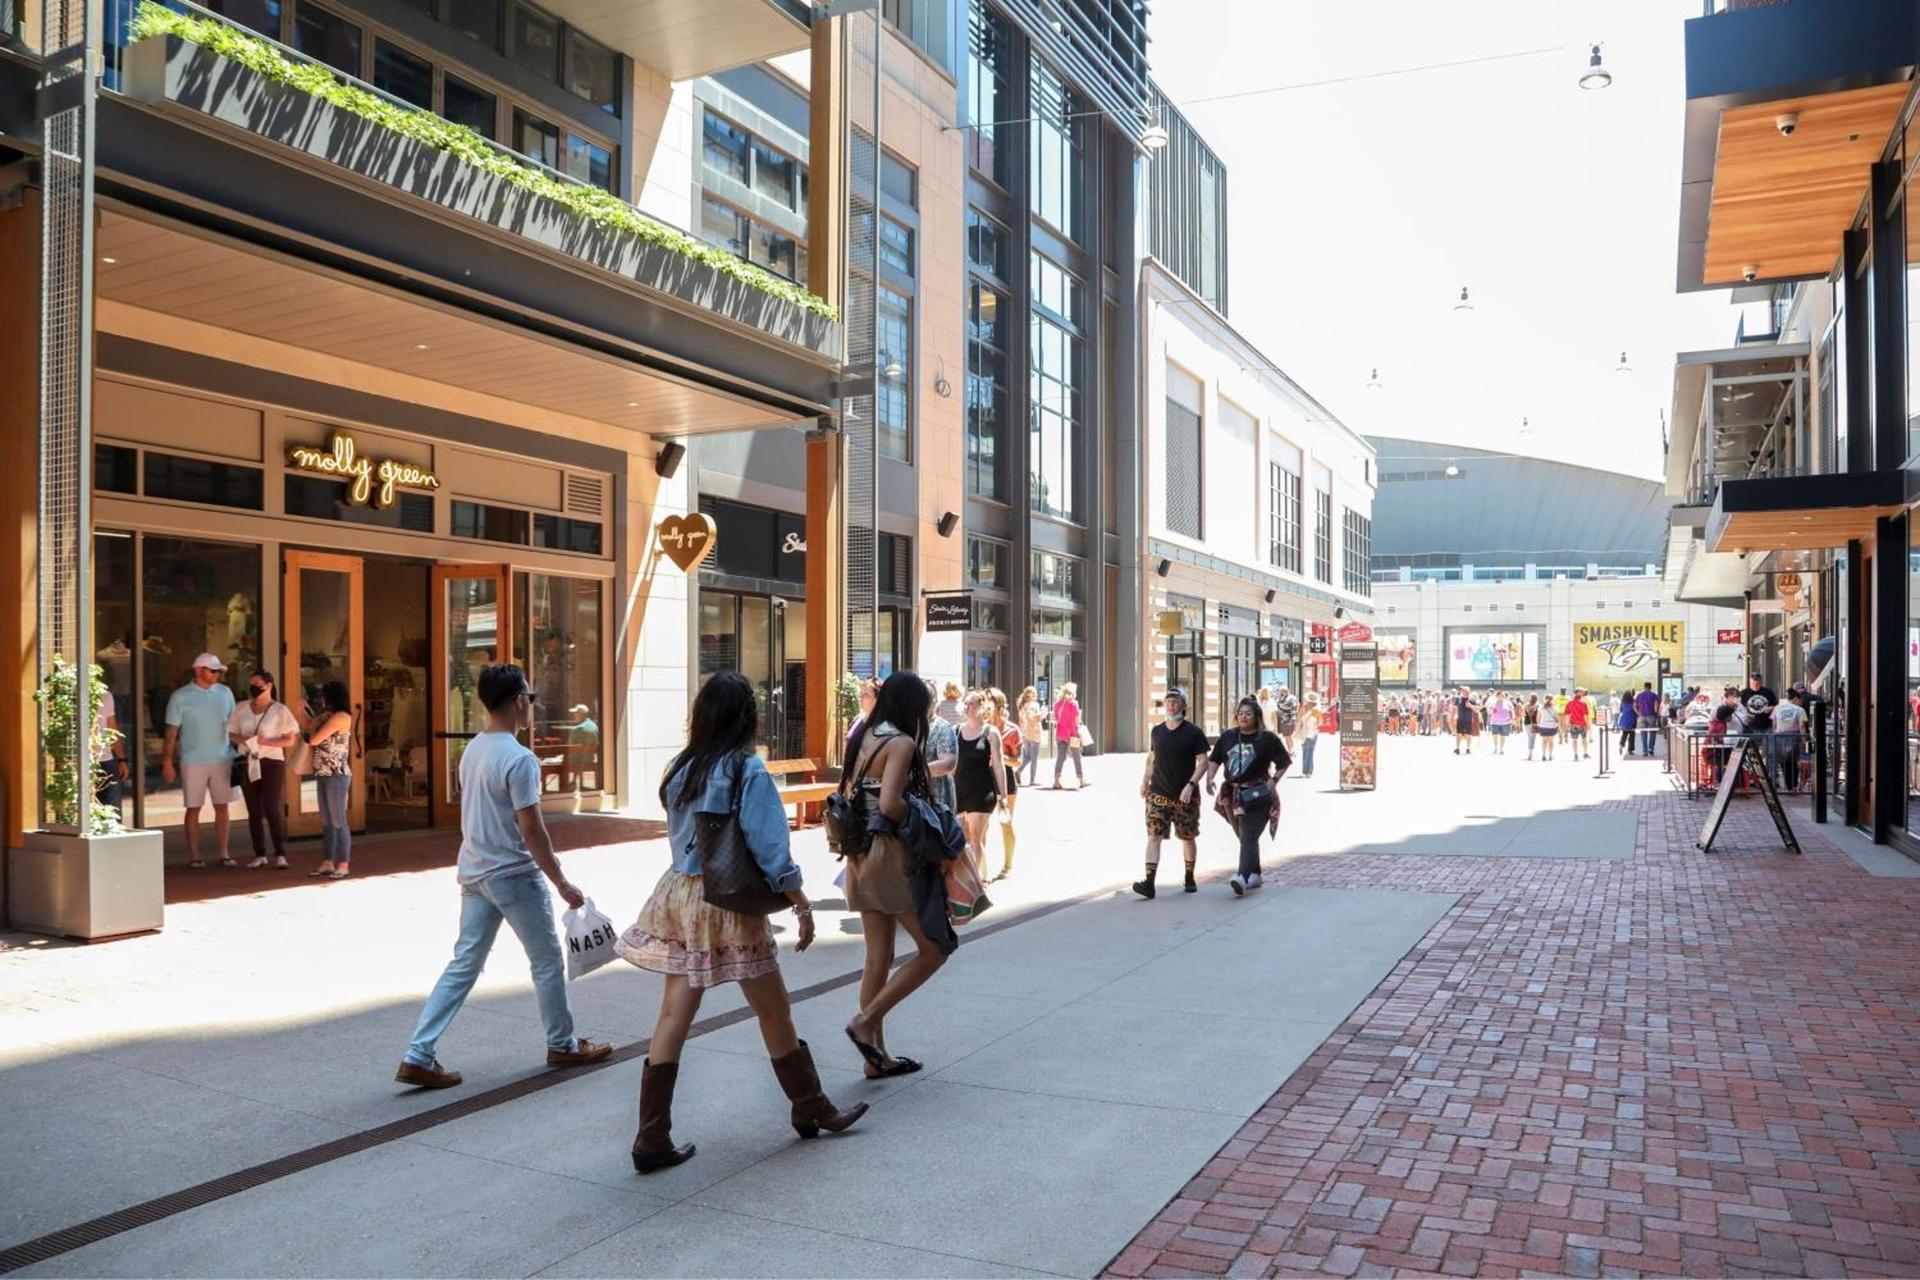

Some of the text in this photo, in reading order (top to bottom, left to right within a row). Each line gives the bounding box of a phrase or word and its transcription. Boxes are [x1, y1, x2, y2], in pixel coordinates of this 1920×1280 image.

[293, 435, 439, 505] molly green
[1580, 624, 1678, 644] SMASHVILLE
[569, 922, 616, 954] NASH
